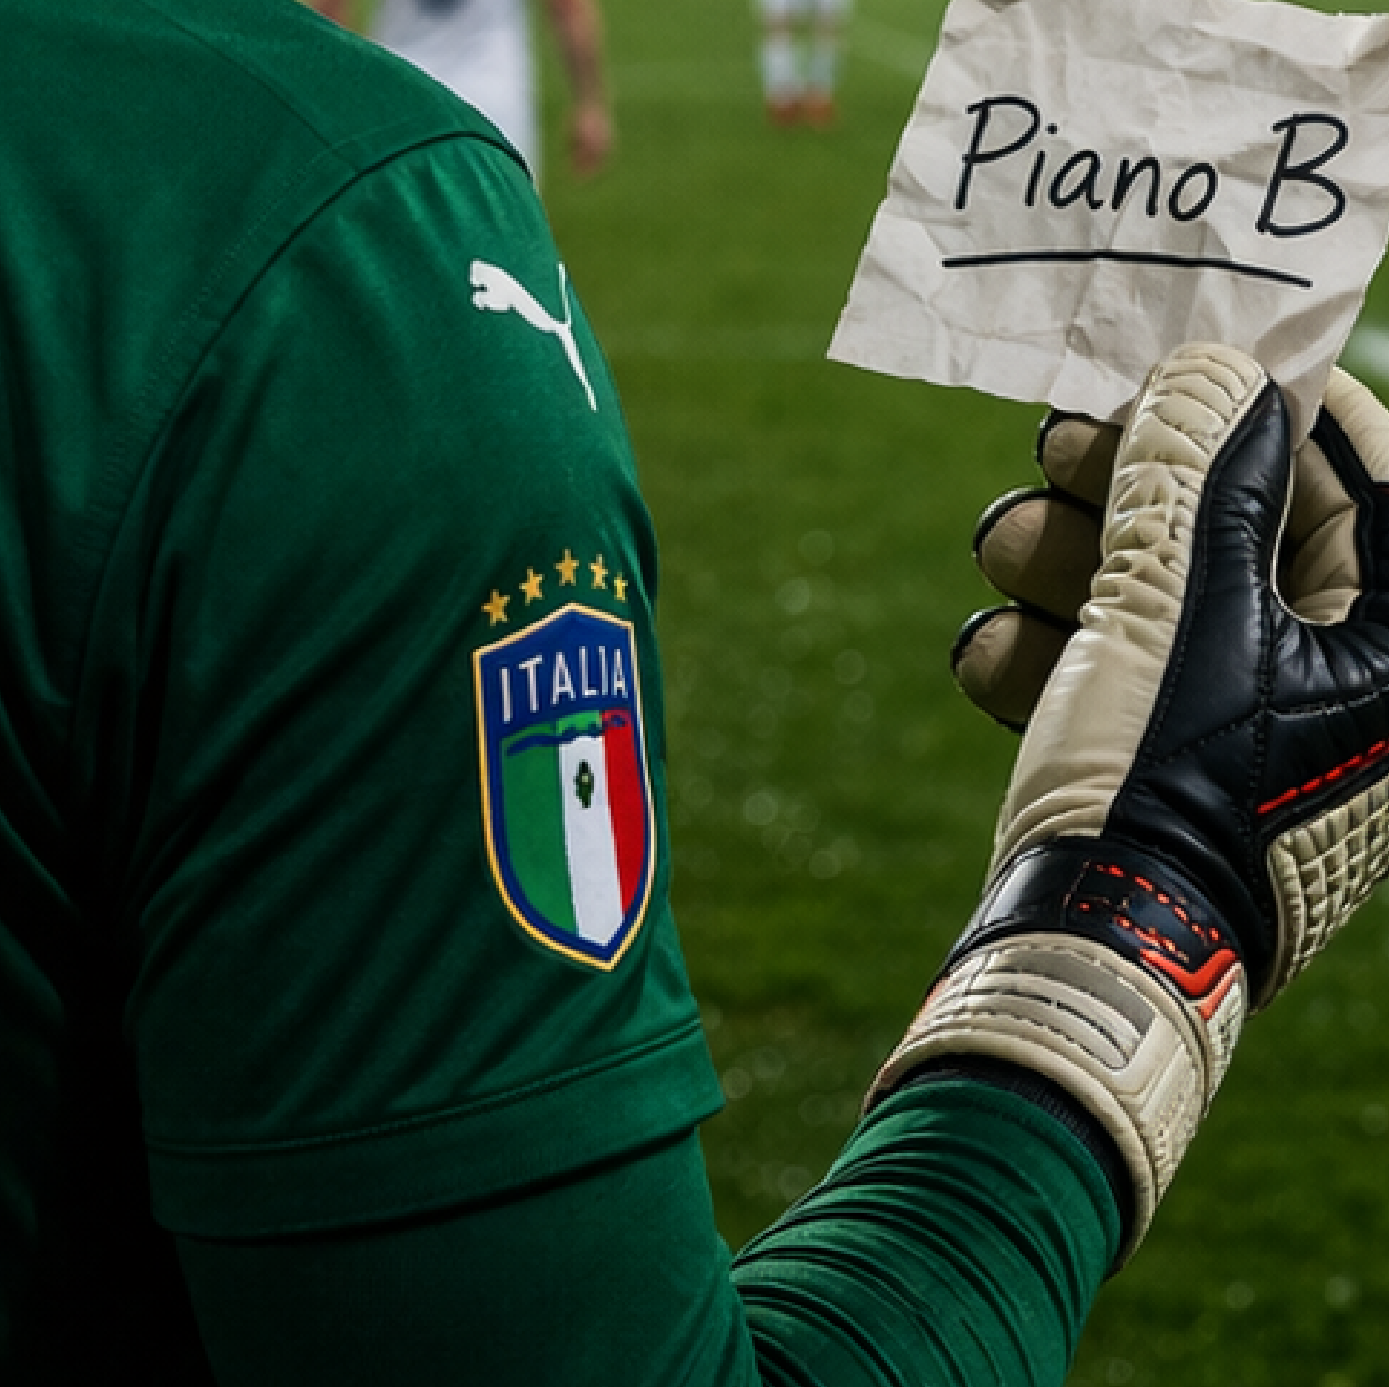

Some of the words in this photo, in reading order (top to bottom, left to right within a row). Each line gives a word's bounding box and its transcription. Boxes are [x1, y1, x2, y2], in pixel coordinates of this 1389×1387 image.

[954, 95, 1219, 222] Piano
[1254, 112, 1350, 237] B
[497, 644, 630, 724] ITALIA
